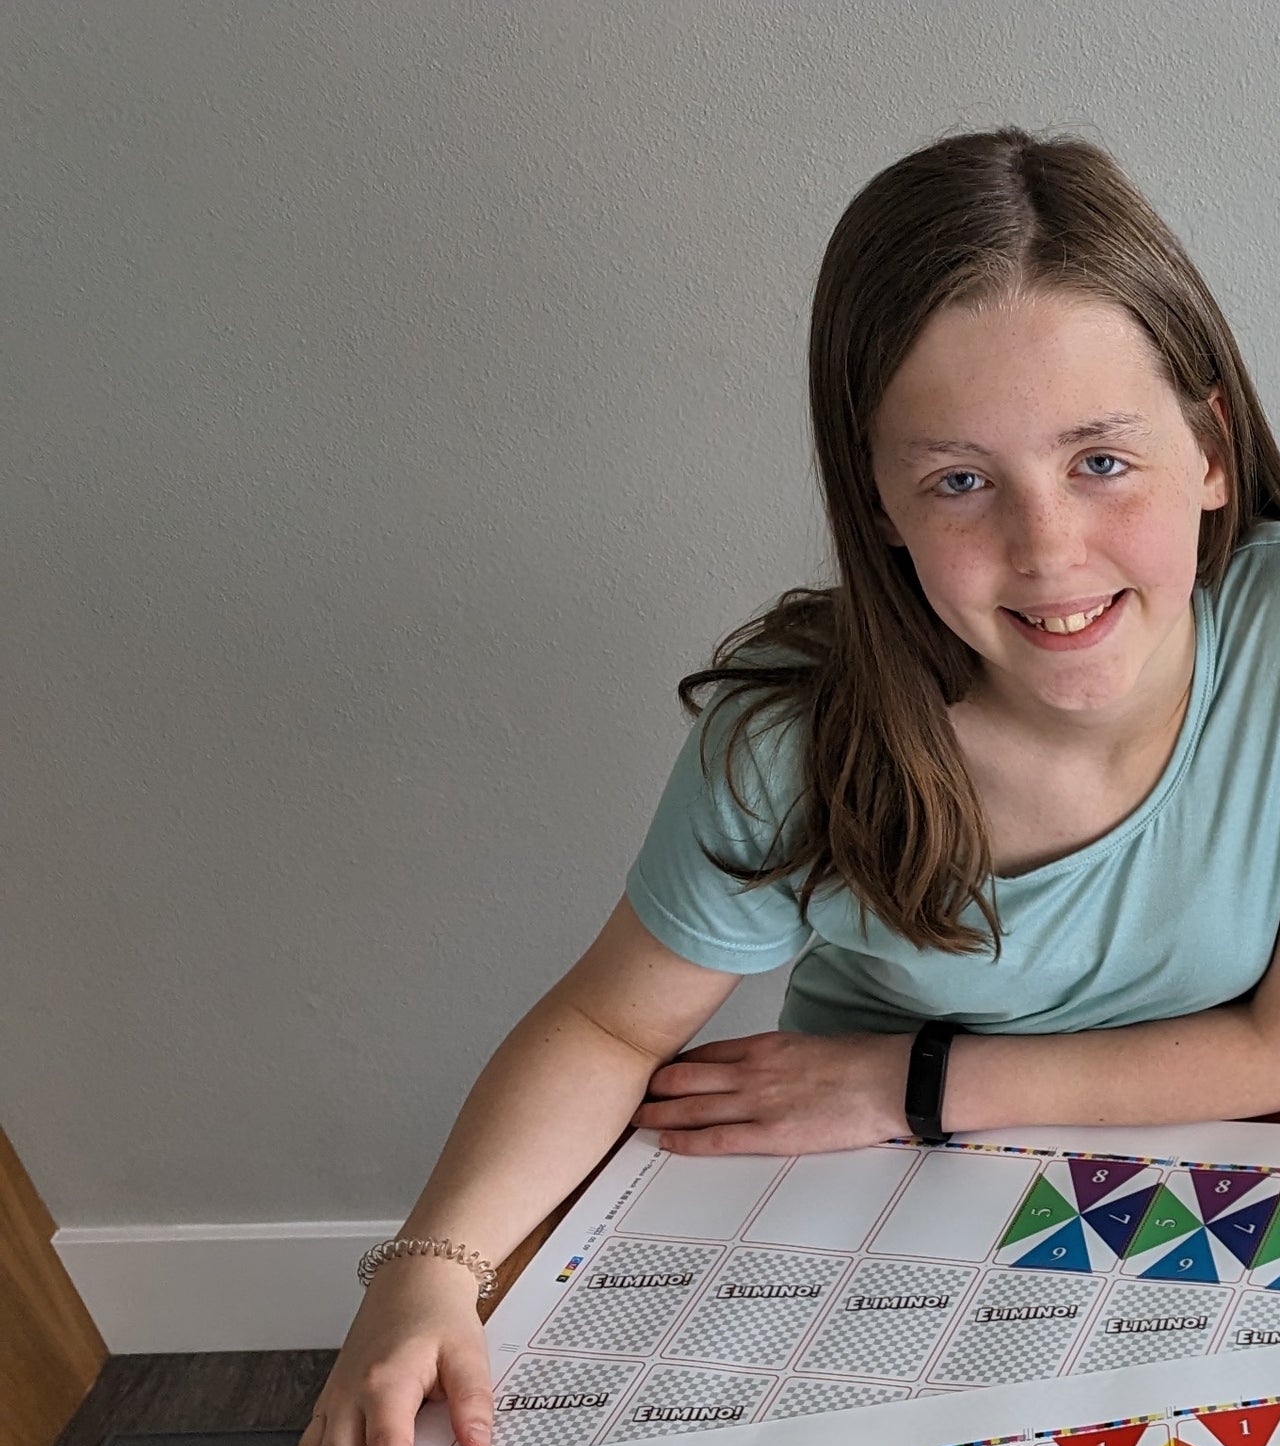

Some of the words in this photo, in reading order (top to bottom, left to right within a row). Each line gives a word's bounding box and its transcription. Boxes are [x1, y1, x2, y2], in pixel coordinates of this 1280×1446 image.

[587, 1273, 693, 1290] ELIMINO!
[717, 1285, 821, 1299] ELIMINO!
[847, 1295, 948, 1311] ELIMINO!
[975, 1305, 1078, 1322] ELIMINO!
[1105, 1316, 1207, 1334] ELIMINO!
[497, 1392, 610, 1411] ELIMINO!
[633, 1406, 743, 1422] ELIMINO!
[1241, 1420, 1251, 1436] 1
